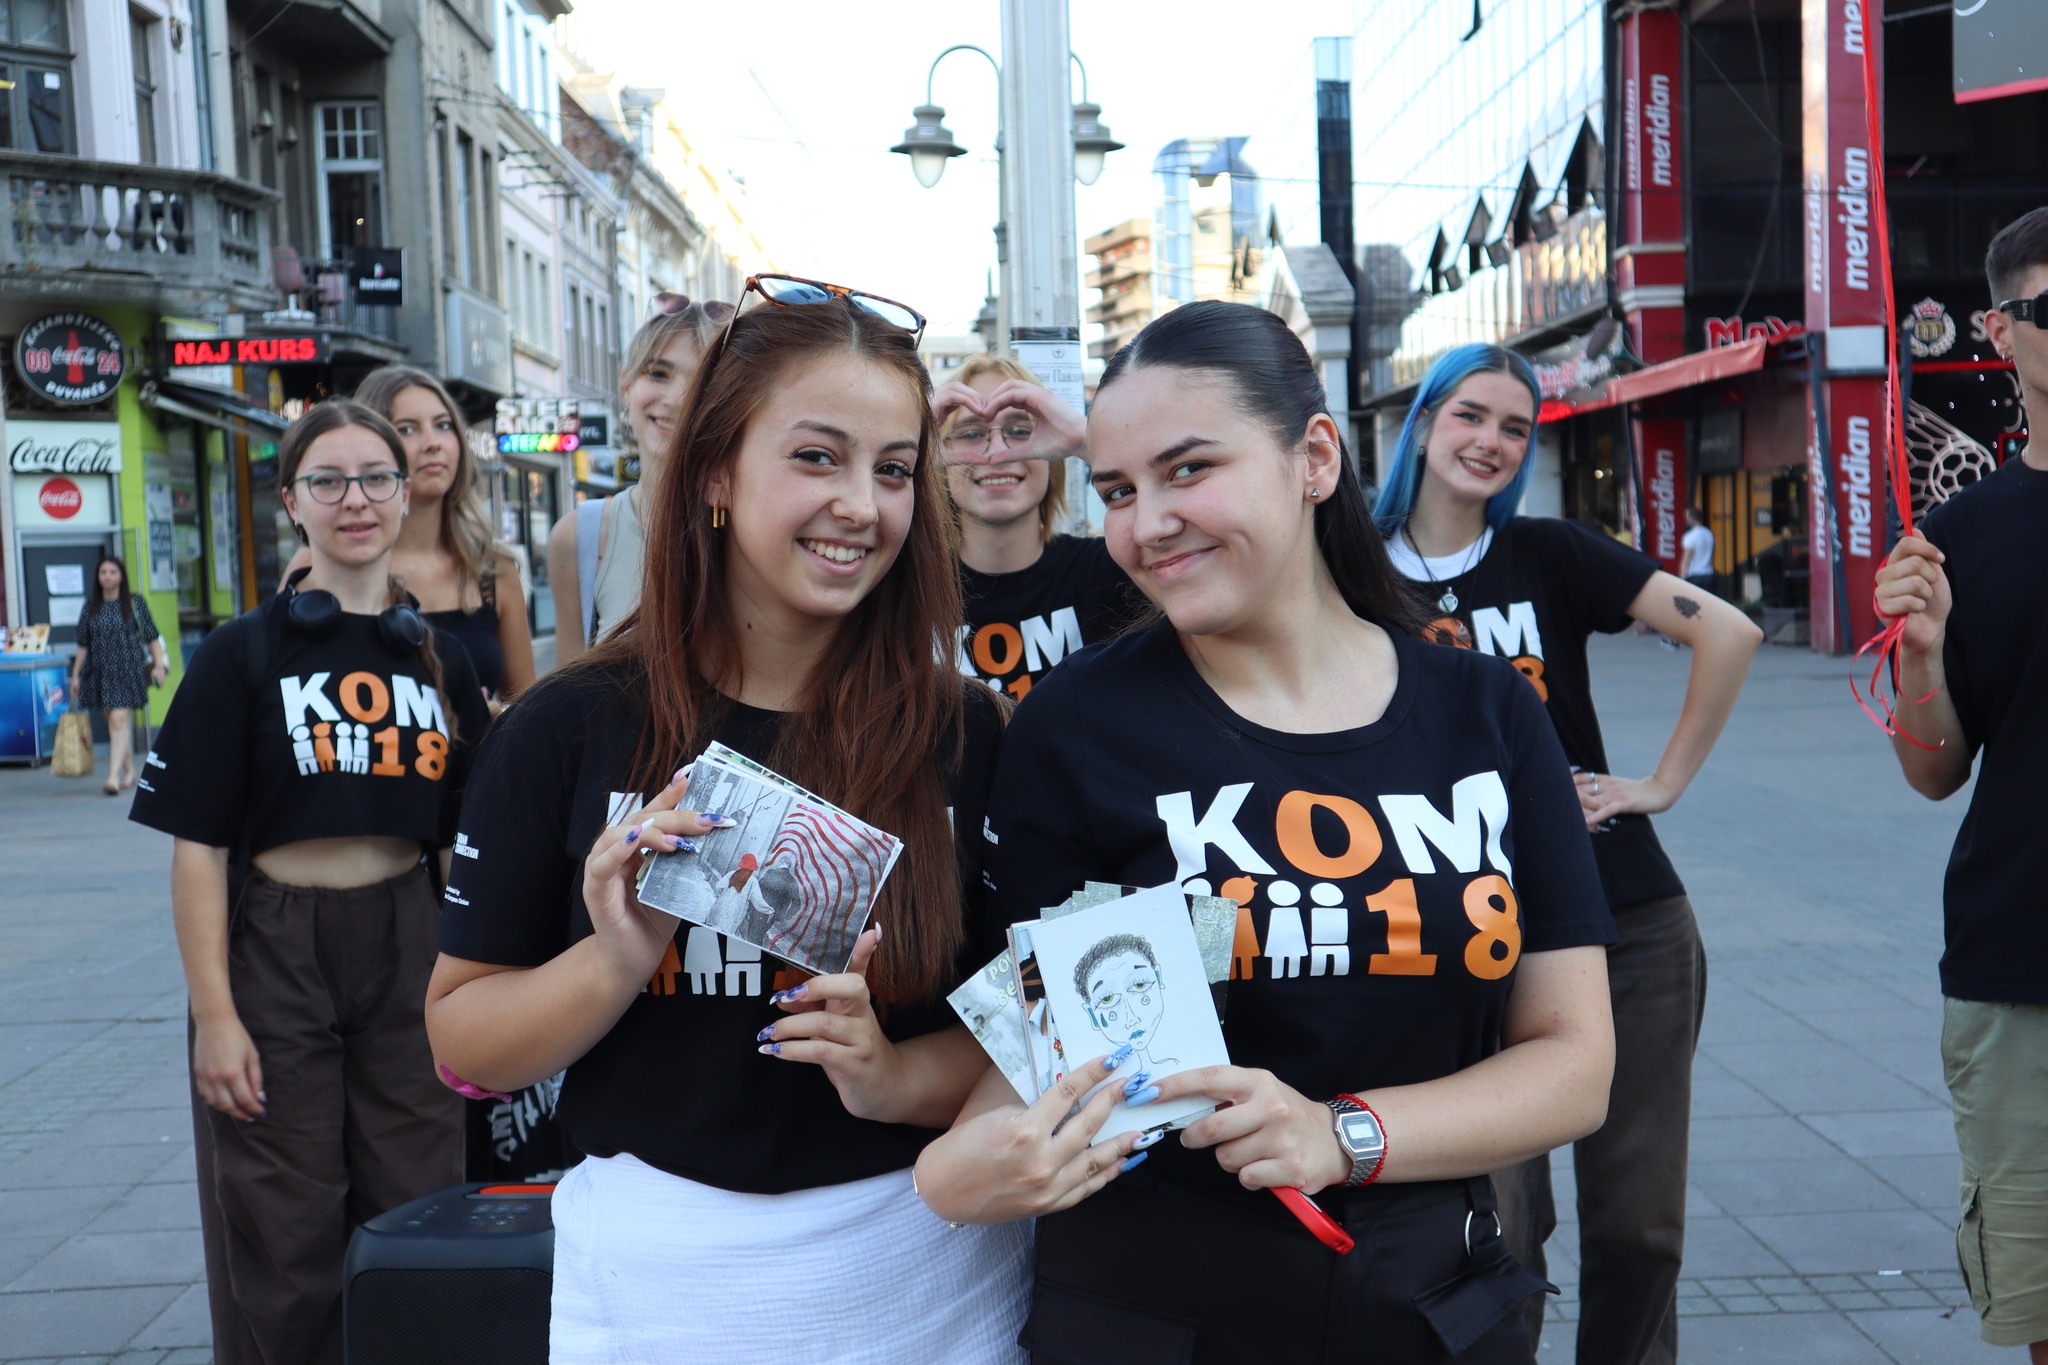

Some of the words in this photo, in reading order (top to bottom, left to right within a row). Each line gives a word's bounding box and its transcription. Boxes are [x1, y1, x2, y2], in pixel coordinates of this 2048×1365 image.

[1645, 74, 1672, 187] meridian
[1838, 147, 1869, 291] meridian
[25, 348, 52, 373] 00
[97, 350, 121, 375] 24
[174, 341, 231, 365] NAJ
[237, 338, 317, 363] KURS
[495, 400, 578, 416] STEF
[496, 416, 557, 433] ANO
[499, 434, 579, 452] STEFANO
[1648, 449, 1676, 559] meridian
[1841, 416, 1872, 558] meridian
[1423, 601, 1544, 661] OM
[280, 671, 450, 743] KOM
[371, 726, 448, 781] 18
[1156, 770, 1514, 889] KOM
[1366, 874, 1521, 980] 18
